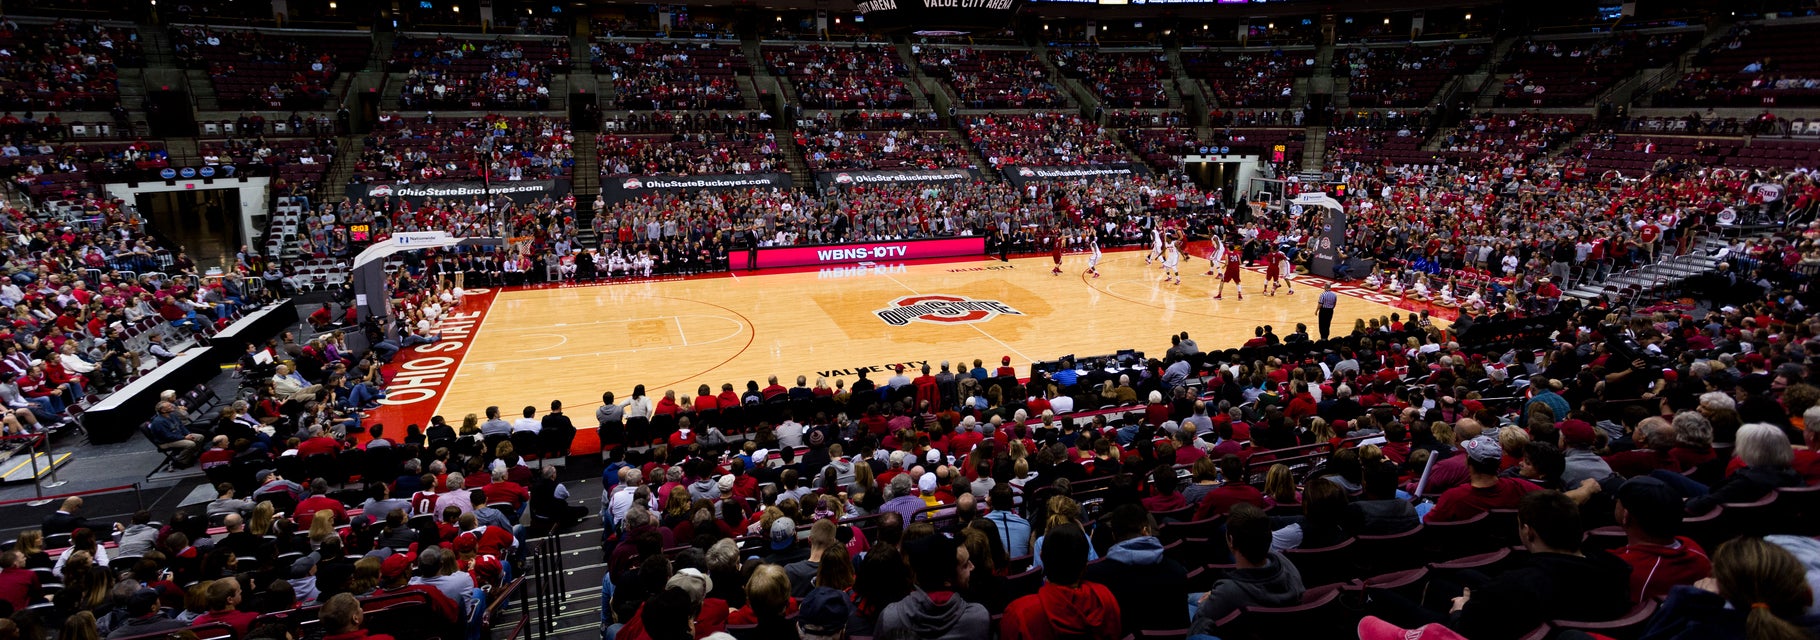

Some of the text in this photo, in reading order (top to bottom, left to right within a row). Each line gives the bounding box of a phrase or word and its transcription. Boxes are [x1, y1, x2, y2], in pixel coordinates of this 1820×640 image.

[870, 0, 897, 11] ARENA
[924, 0, 1013, 9] VALUE CITY ARENA
[646, 178, 771, 188] OhioStateBuckeyes.com
[398, 185, 543, 197] OhioStateBuckeyes.com
[817, 246, 907, 261] WBNS-10TV
[885, 361, 927, 371] CTY
[377, 356, 455, 406] OHIO
[420, 498, 430, 514] 0
